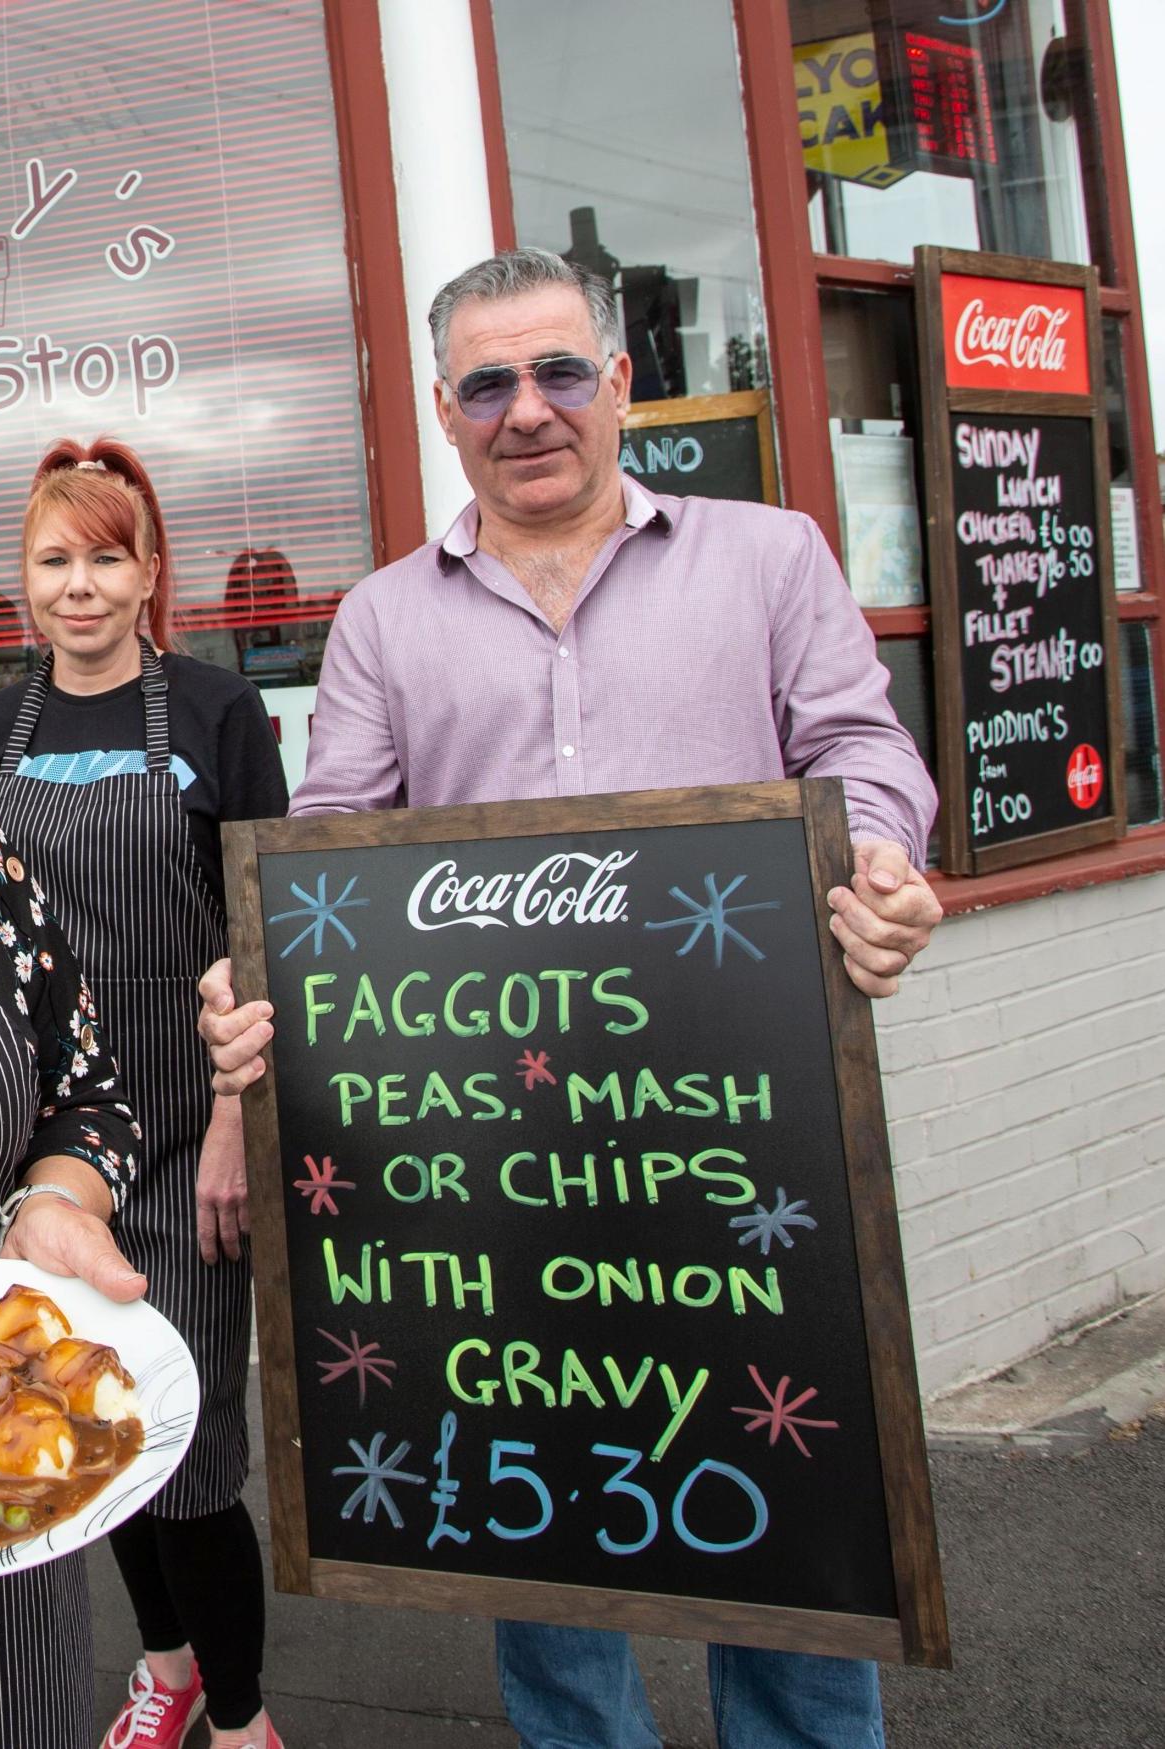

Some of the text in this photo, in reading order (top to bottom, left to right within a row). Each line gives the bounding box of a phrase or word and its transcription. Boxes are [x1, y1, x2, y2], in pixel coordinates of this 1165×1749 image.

[954, 299, 1070, 371] Coca-Cola
[990, 635, 1062, 692] STEAK
[407, 850, 639, 931] Coca-Cola
[304, 967, 649, 1047] FAGGOTS
[567, 1068, 772, 1124] MASH
[383, 1153, 470, 1204] OR
[542, 1255, 784, 1315] ONION
[446, 1338, 709, 1462] GRAVY
